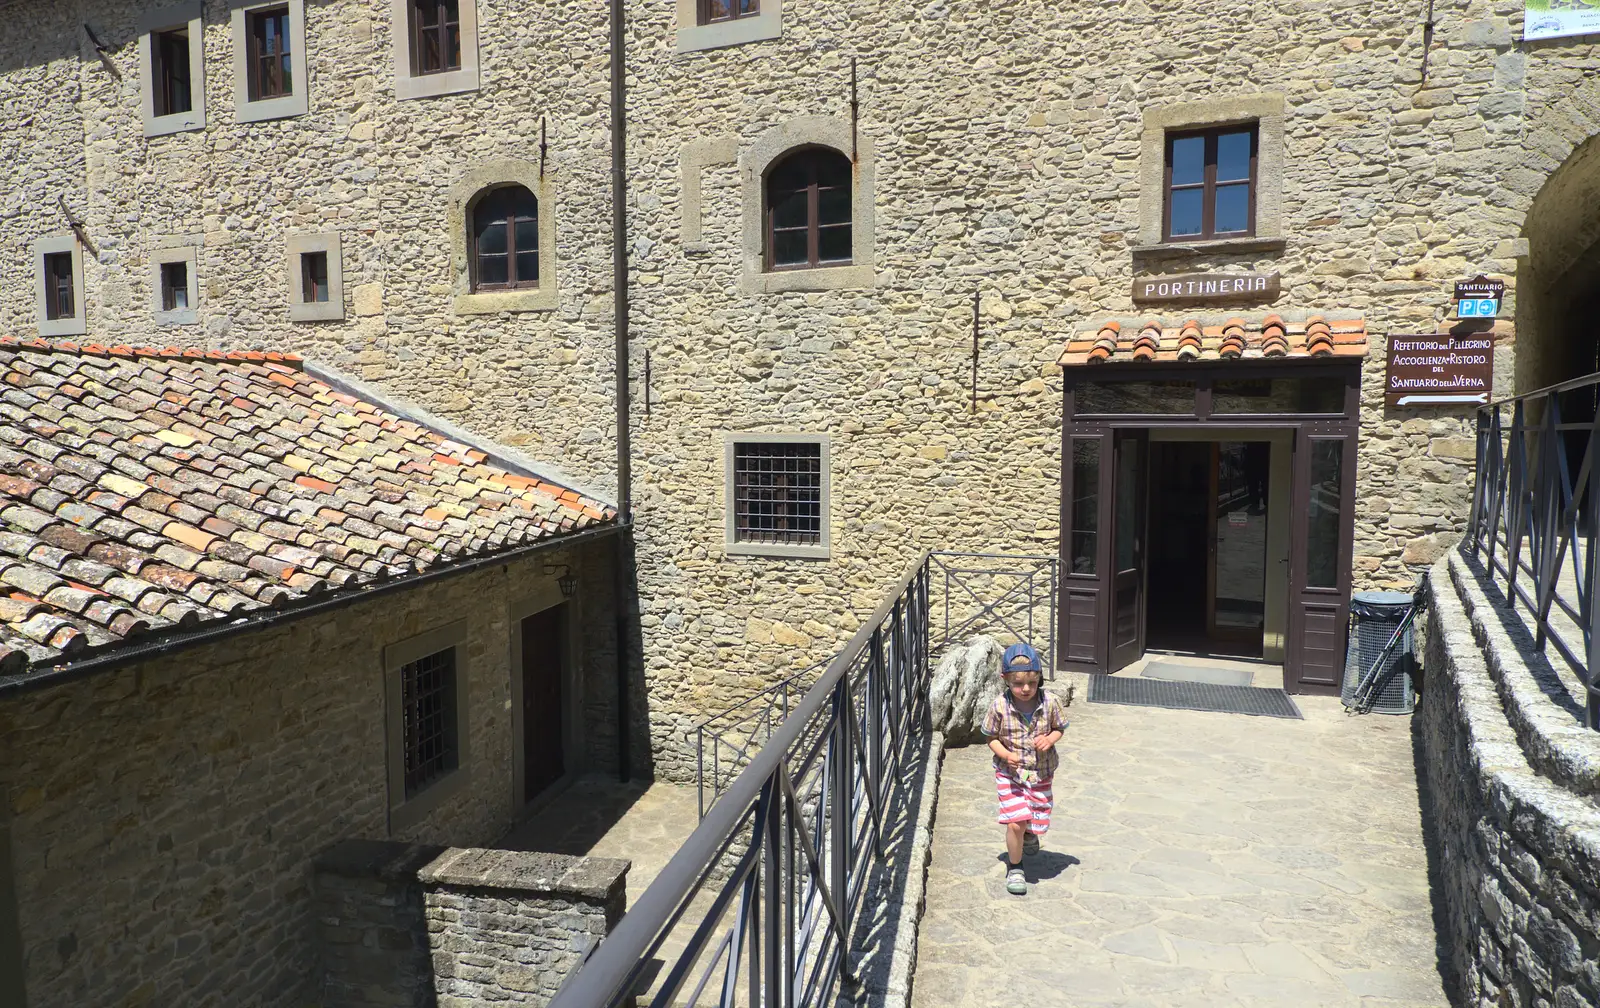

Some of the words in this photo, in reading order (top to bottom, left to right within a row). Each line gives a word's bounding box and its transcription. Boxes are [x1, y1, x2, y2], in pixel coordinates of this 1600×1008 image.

[1145, 277, 1266, 296] PORTINERIA
[1458, 283, 1503, 291] SANTUARIO
[1393, 339, 1438, 351] REFETTORIO
[1391, 376, 1438, 388] SANTUARIO
[1454, 375, 1484, 387] VERNA
